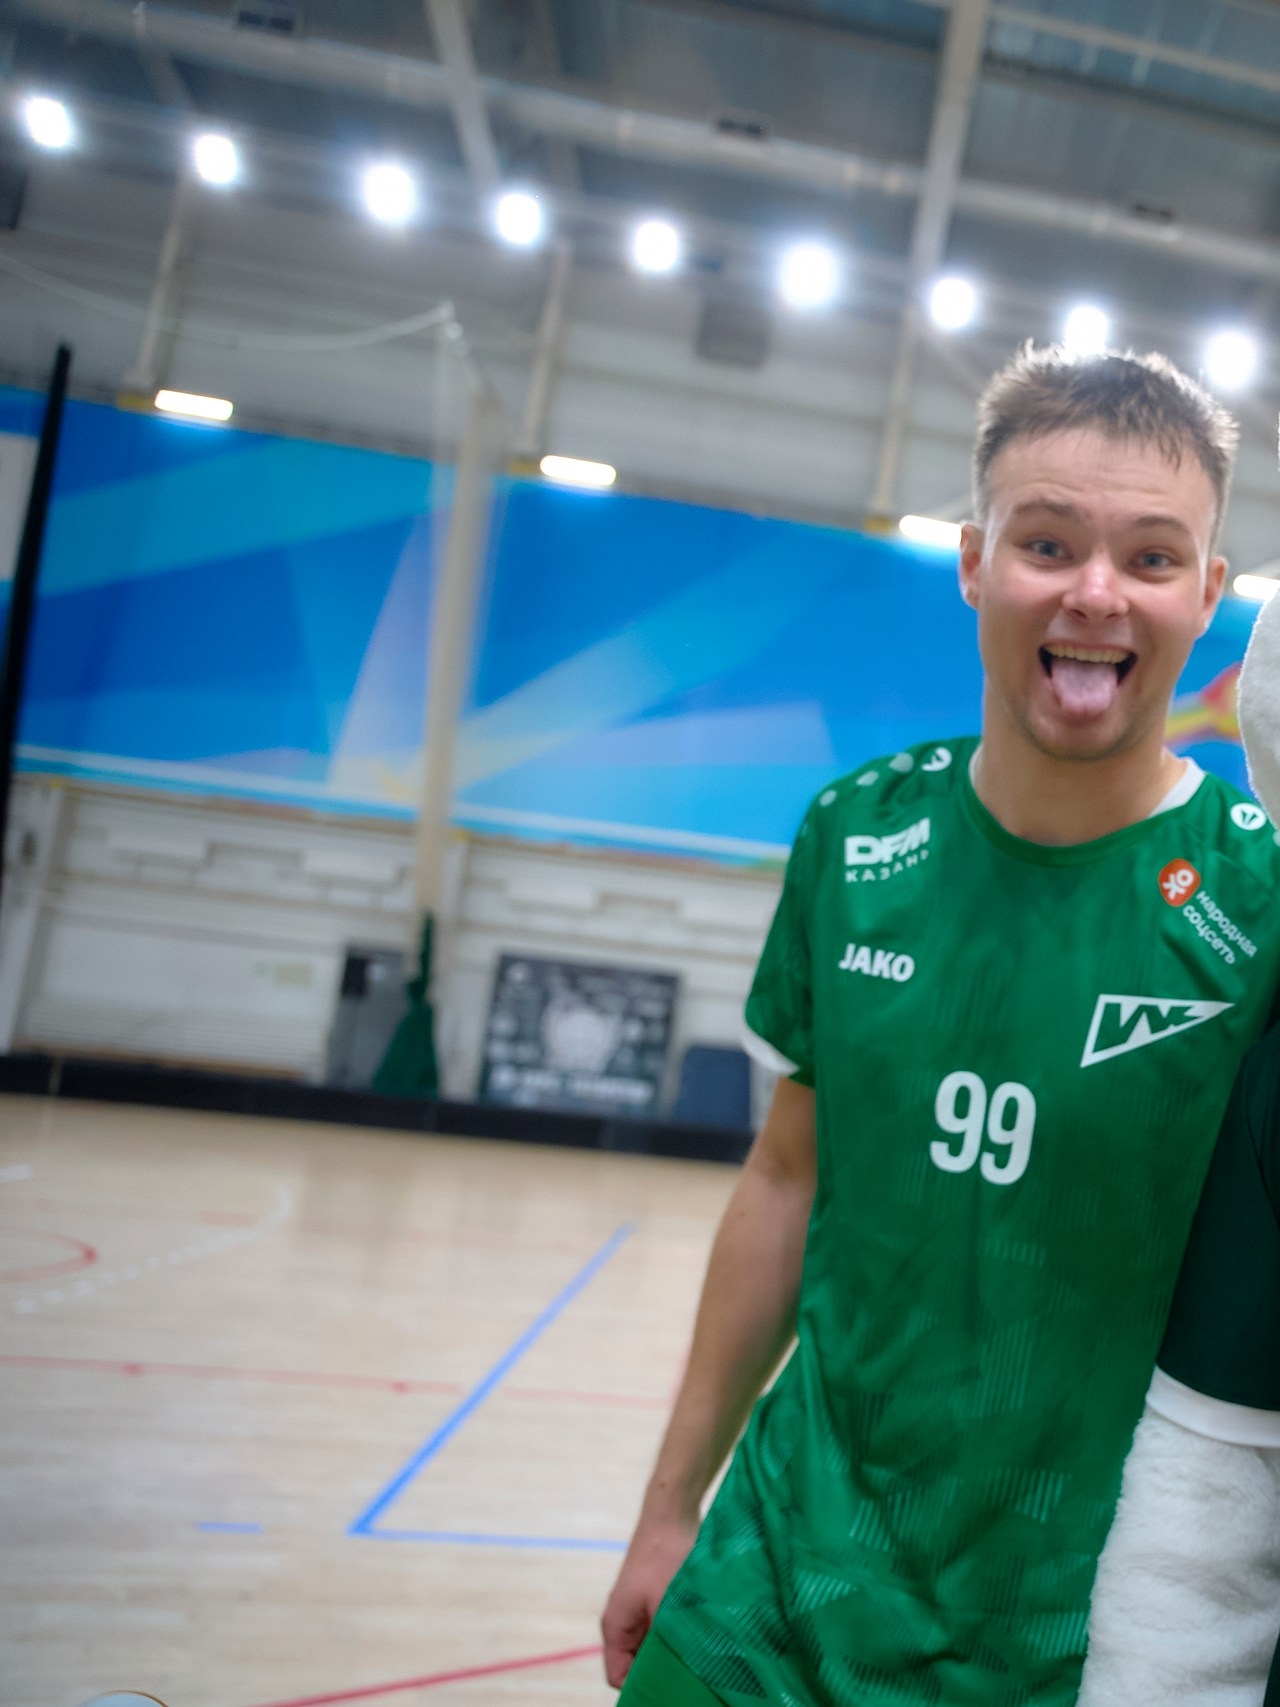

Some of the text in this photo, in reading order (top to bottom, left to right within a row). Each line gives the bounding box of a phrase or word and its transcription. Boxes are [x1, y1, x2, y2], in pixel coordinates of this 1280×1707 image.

[844, 817, 931, 866] DFM
[1182, 904, 1236, 965] соцсеть
[1195, 890, 1258, 958] народная
[838, 943, 916, 983] JAKO
[929, 1070, 1037, 1186] 99
